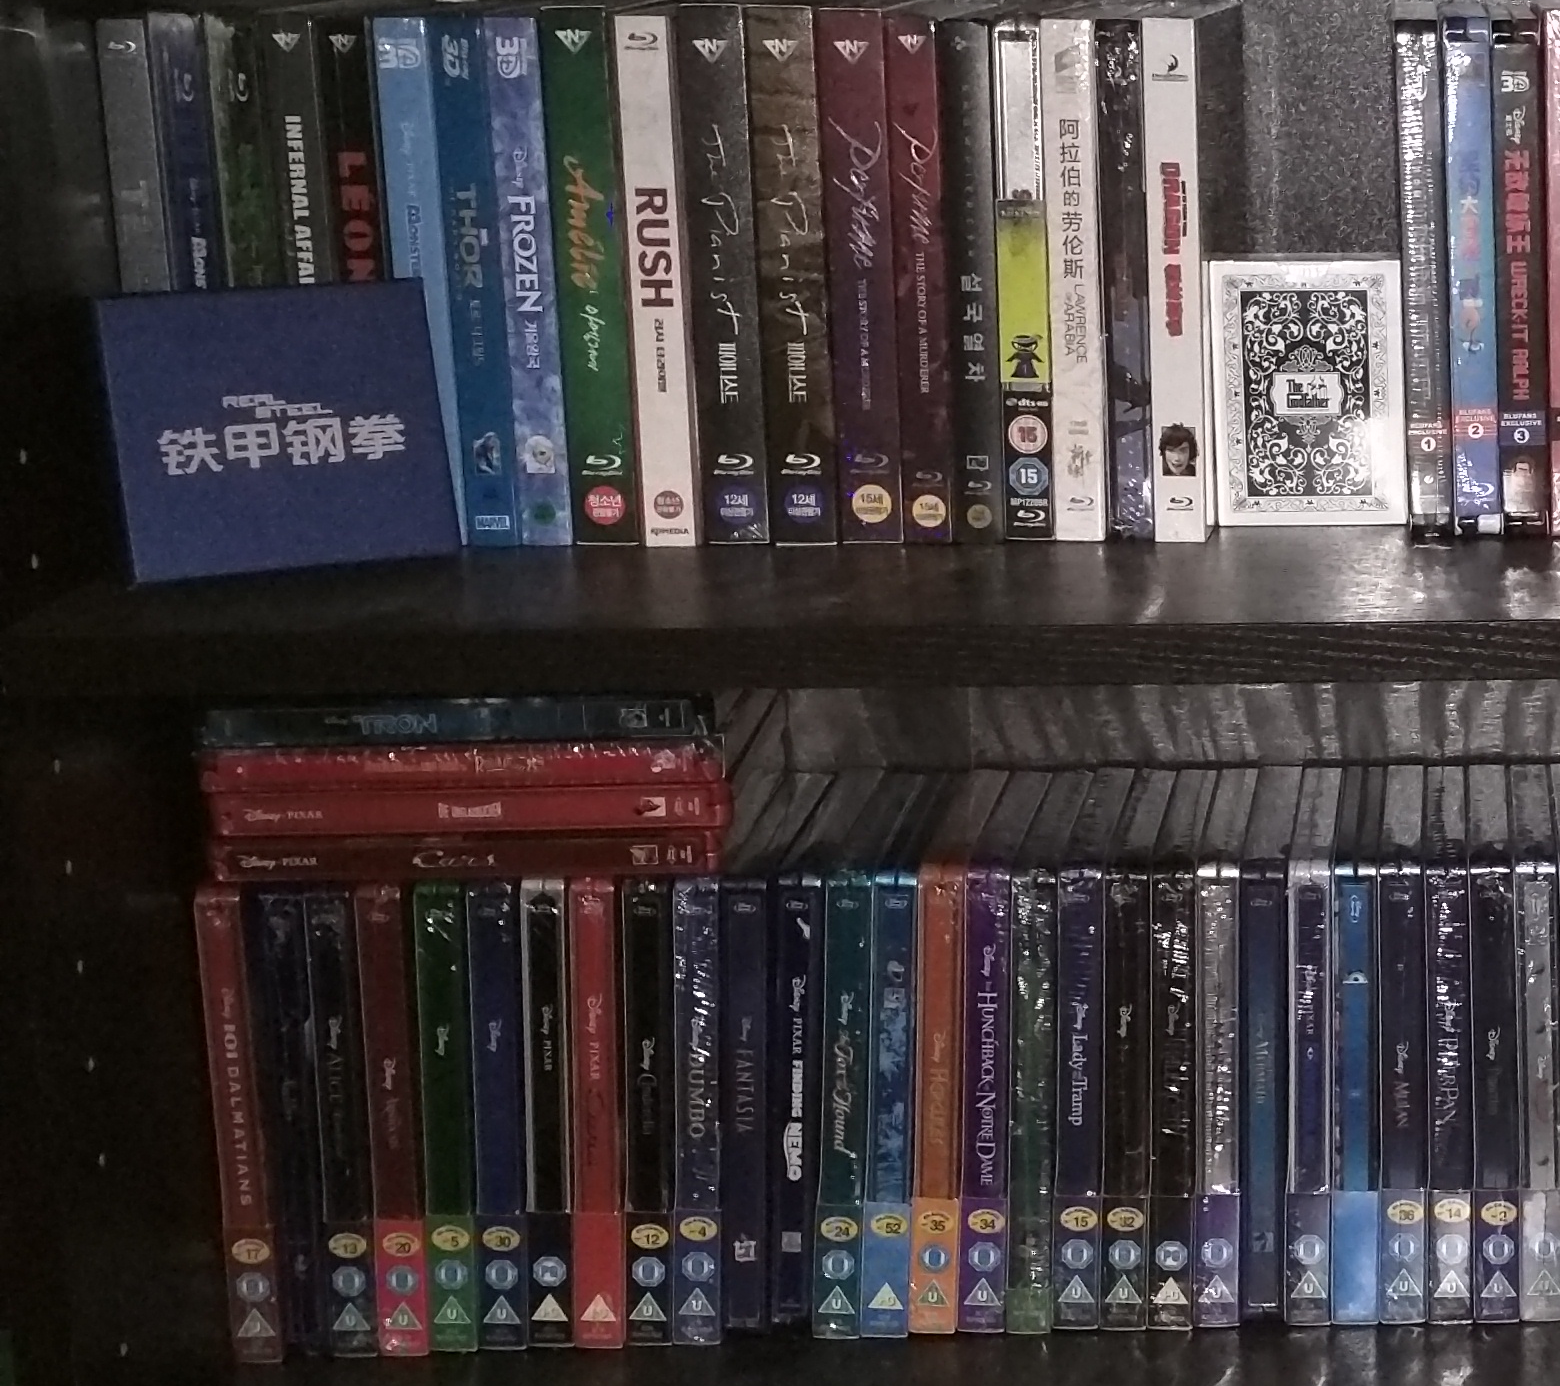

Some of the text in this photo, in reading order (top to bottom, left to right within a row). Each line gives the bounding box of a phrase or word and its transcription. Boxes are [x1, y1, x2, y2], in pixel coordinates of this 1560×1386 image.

[283, 115, 317, 284] INFERNAL AFFAI
[562, 154, 605, 290] Amélie
[828, 115, 883, 268] Perfume
[893, 121, 938, 245] Perfume
[1058, 118, 1083, 279] 阿拉伯的劳伦斯
[1161, 161, 1182, 255] DRAGON
[1503, 149, 1531, 254] 无敌破坏王
[454, 182, 484, 288] THOR
[507, 195, 543, 313] FROZEN
[634, 187, 674, 308] RUSH
[701, 192, 740, 336] Pianist
[770, 191, 809, 336] Pianist
[916, 274, 927, 307] STORY
[960, 272, 985, 383] 설국열차
[1063, 302, 1077, 357] ARABIA
[1073, 283, 1088, 364] LAWRENCE
[1509, 260, 1530, 401] WRECK-IT RALPH
[919, 336, 931, 395] MURDERER
[1285, 378, 1304, 393] The
[1286, 392, 1331, 409] Godfather
[156, 413, 407, 476] 铁甲钢拳
[1018, 426, 1038, 443] 15
[1019, 468, 1038, 484] 15
[353, 713, 438, 736] TRON
[543, 1038, 554, 1072] PIXAR
[588, 1040, 601, 1081] PIXAR
[791, 1017, 805, 1055] PIXAR
[1067, 1033, 1089, 1126] Lady Tramp
[222, 1023, 253, 1207] 101 DALMATIANS
[687, 1051, 706, 1139] DUMBO
[734, 1048, 755, 1133] FANTASIA
[790, 1059, 805, 1117] FINDING
[976, 991, 1000, 1186] HUNCHBACK NOTRE DAME
[783, 1122, 805, 1182] NEMO
